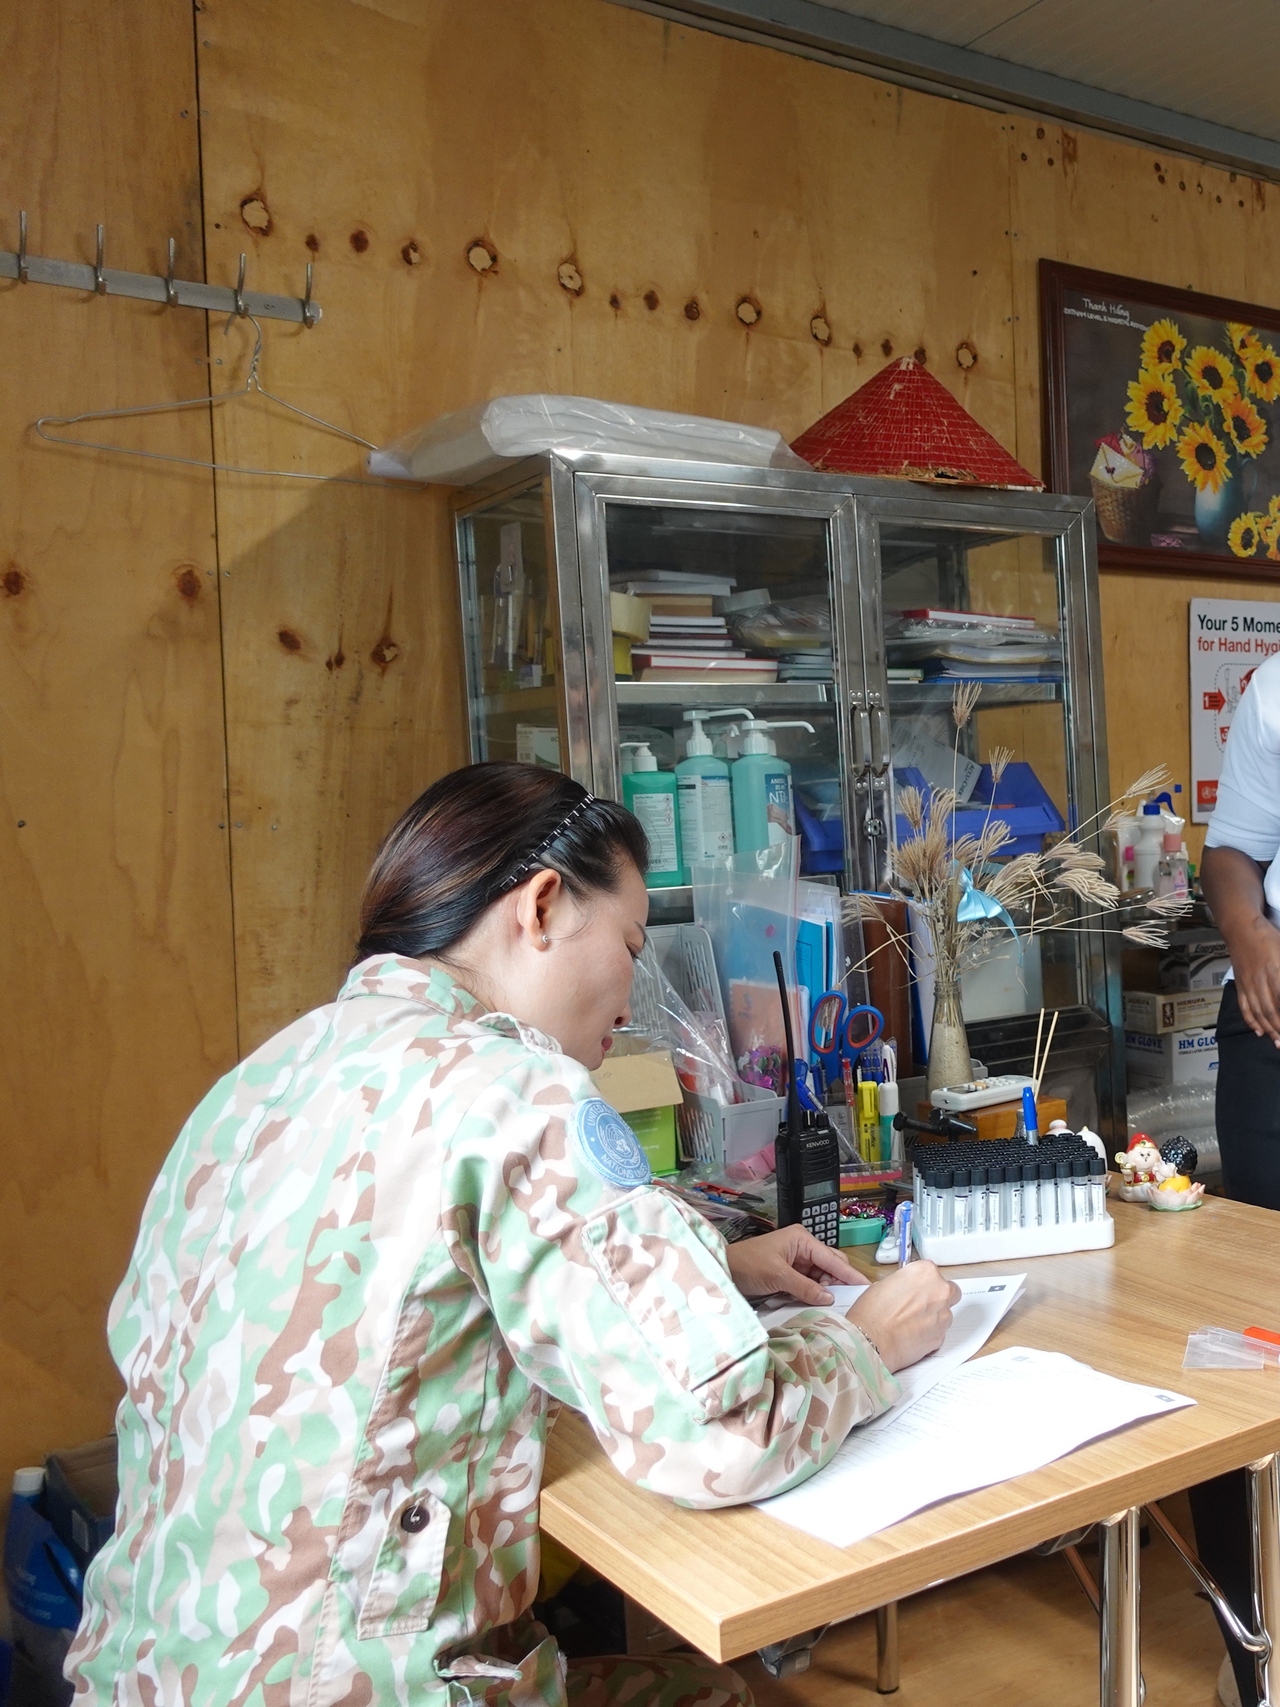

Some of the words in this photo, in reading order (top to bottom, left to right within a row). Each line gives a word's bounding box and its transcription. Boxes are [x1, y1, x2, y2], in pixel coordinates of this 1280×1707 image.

[1198, 614, 1227, 631] Your
[1231, 617, 1239, 631] 5
[1197, 637, 1215, 651] for
[1218, 638, 1250, 652] Hand
[1137, 1036, 1163, 1049] GLOVE
[1178, 1039, 1195, 1050] HM
[1197, 1036, 1216, 1048] GLO
[587, 1104, 605, 1126] UNITED
[806, 1139, 830, 1148] KENWOOD
[601, 1154, 634, 1178] NATIONS
